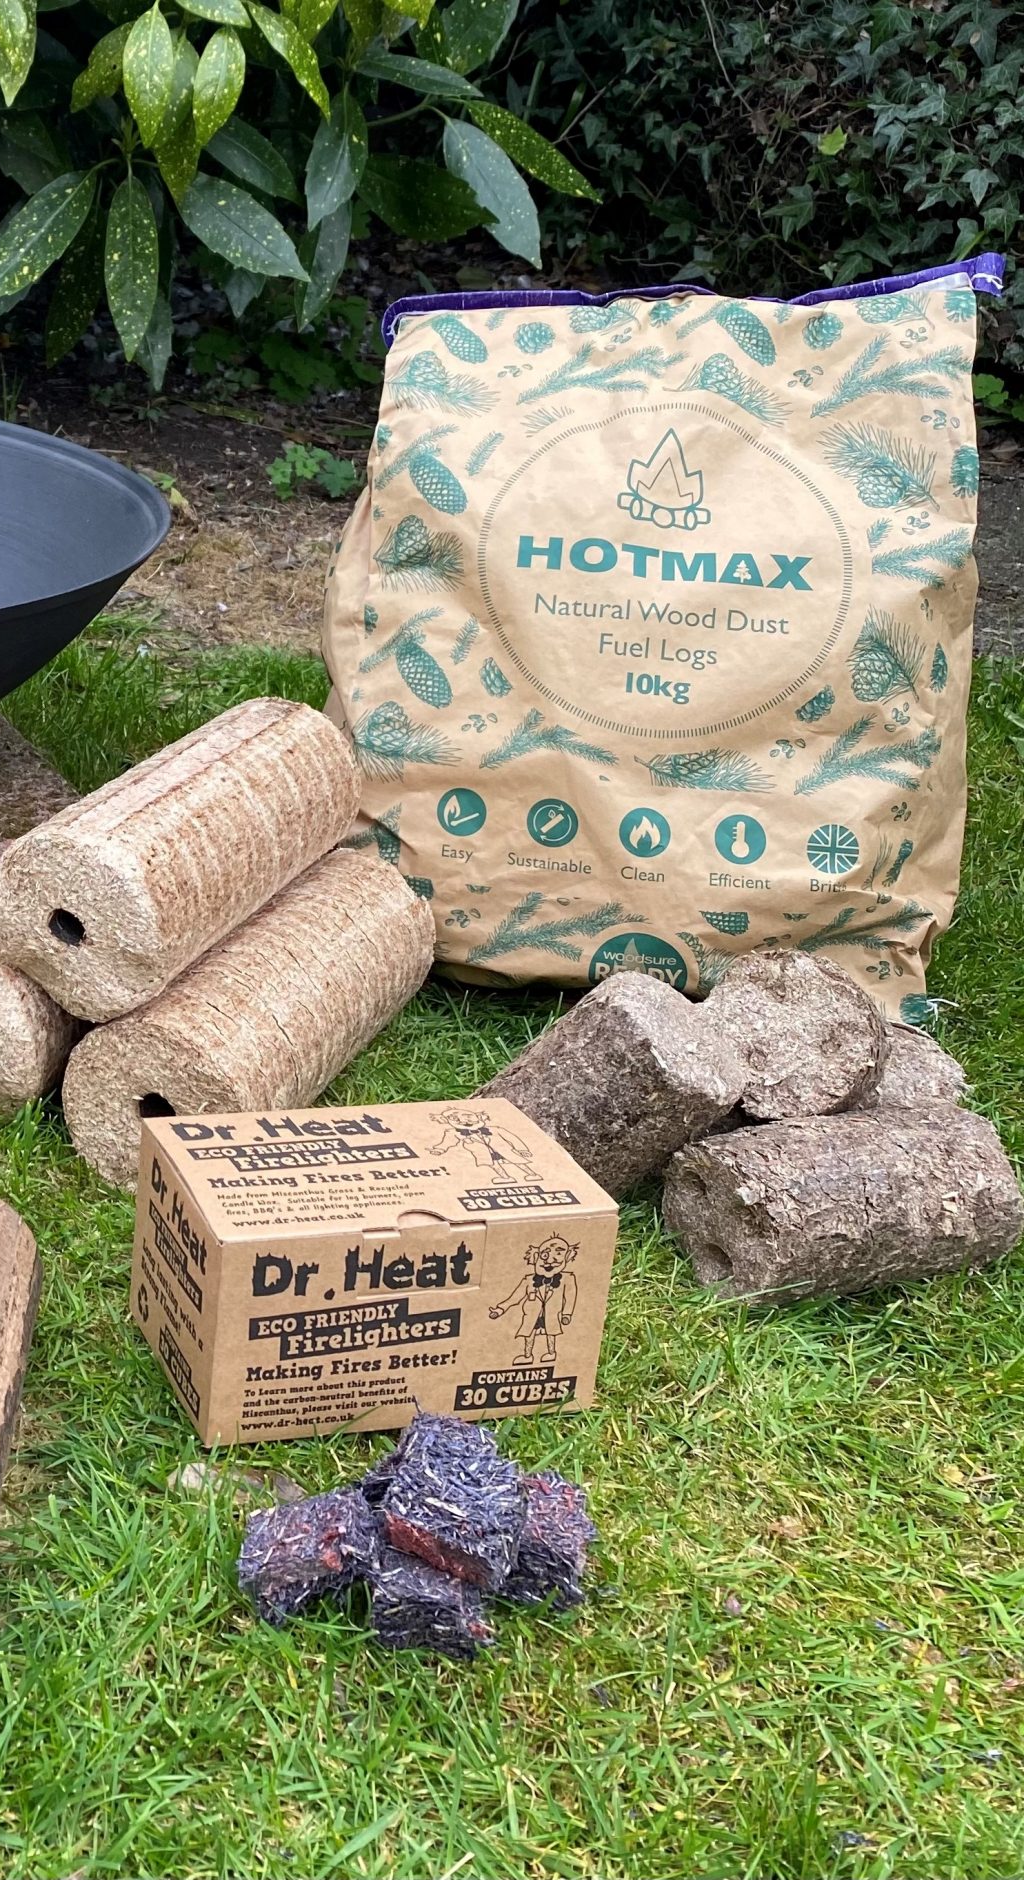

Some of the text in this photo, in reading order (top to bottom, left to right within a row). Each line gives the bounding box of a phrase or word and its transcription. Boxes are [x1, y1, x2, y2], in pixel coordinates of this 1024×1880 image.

[516, 535, 813, 591] HOTMAX
[534, 593, 789, 635] Natural Wood Dust
[599, 633, 718, 670] Fuel Logs
[625, 672, 691, 705] 10kg
[441, 844, 473, 864] Easy
[507, 852, 592, 875] Sustainable
[620, 866, 665, 883] Clean
[709, 872, 771, 891] Efficient
[603, 950, 677, 966] woodsure
[595, 963, 683, 987] RDY
[194, 1140, 341, 1158] ECO FRIENDLY
[234, 1146, 411, 1170] Firelighters
[207, 1166, 451, 1188] Making Fires Better!
[246, 1191, 268, 1199] from
[369, 1184, 410, 1193] Recycled
[346, 1193, 360, 1201] log
[404, 1190, 425, 1198] open
[462, 1192, 572, 1210] 30 CUBES
[469, 1186, 539, 1197] CONTAINS
[313, 1201, 350, 1211] lighting
[232, 1212, 366, 1228] www.dr-heat.co.uk
[156, 1263, 179, 1314] lasting
[179, 1307, 197, 1340] with
[198, 1338, 204, 1352] a
[258, 1303, 399, 1336] ECO FRIENDLY
[287, 1318, 452, 1355] Firelighters
[246, 1350, 457, 1381] Making Fires Better!
[170, 1353, 199, 1416] CUBES
[244, 1376, 406, 1397] To Learn more about this product
[477, 1369, 548, 1384] CONTAINS
[243, 1386, 408, 1408] and the carbon-neutral benefits of
[461, 1380, 570, 1406] 30 CUBES
[242, 1407, 300, 1418] Miscanthus,
[302, 1404, 332, 1415] please
[335, 1400, 358, 1410] visit
[361, 1400, 377, 1408] our
[241, 1413, 355, 1430] www.dr-heat.co.uk
